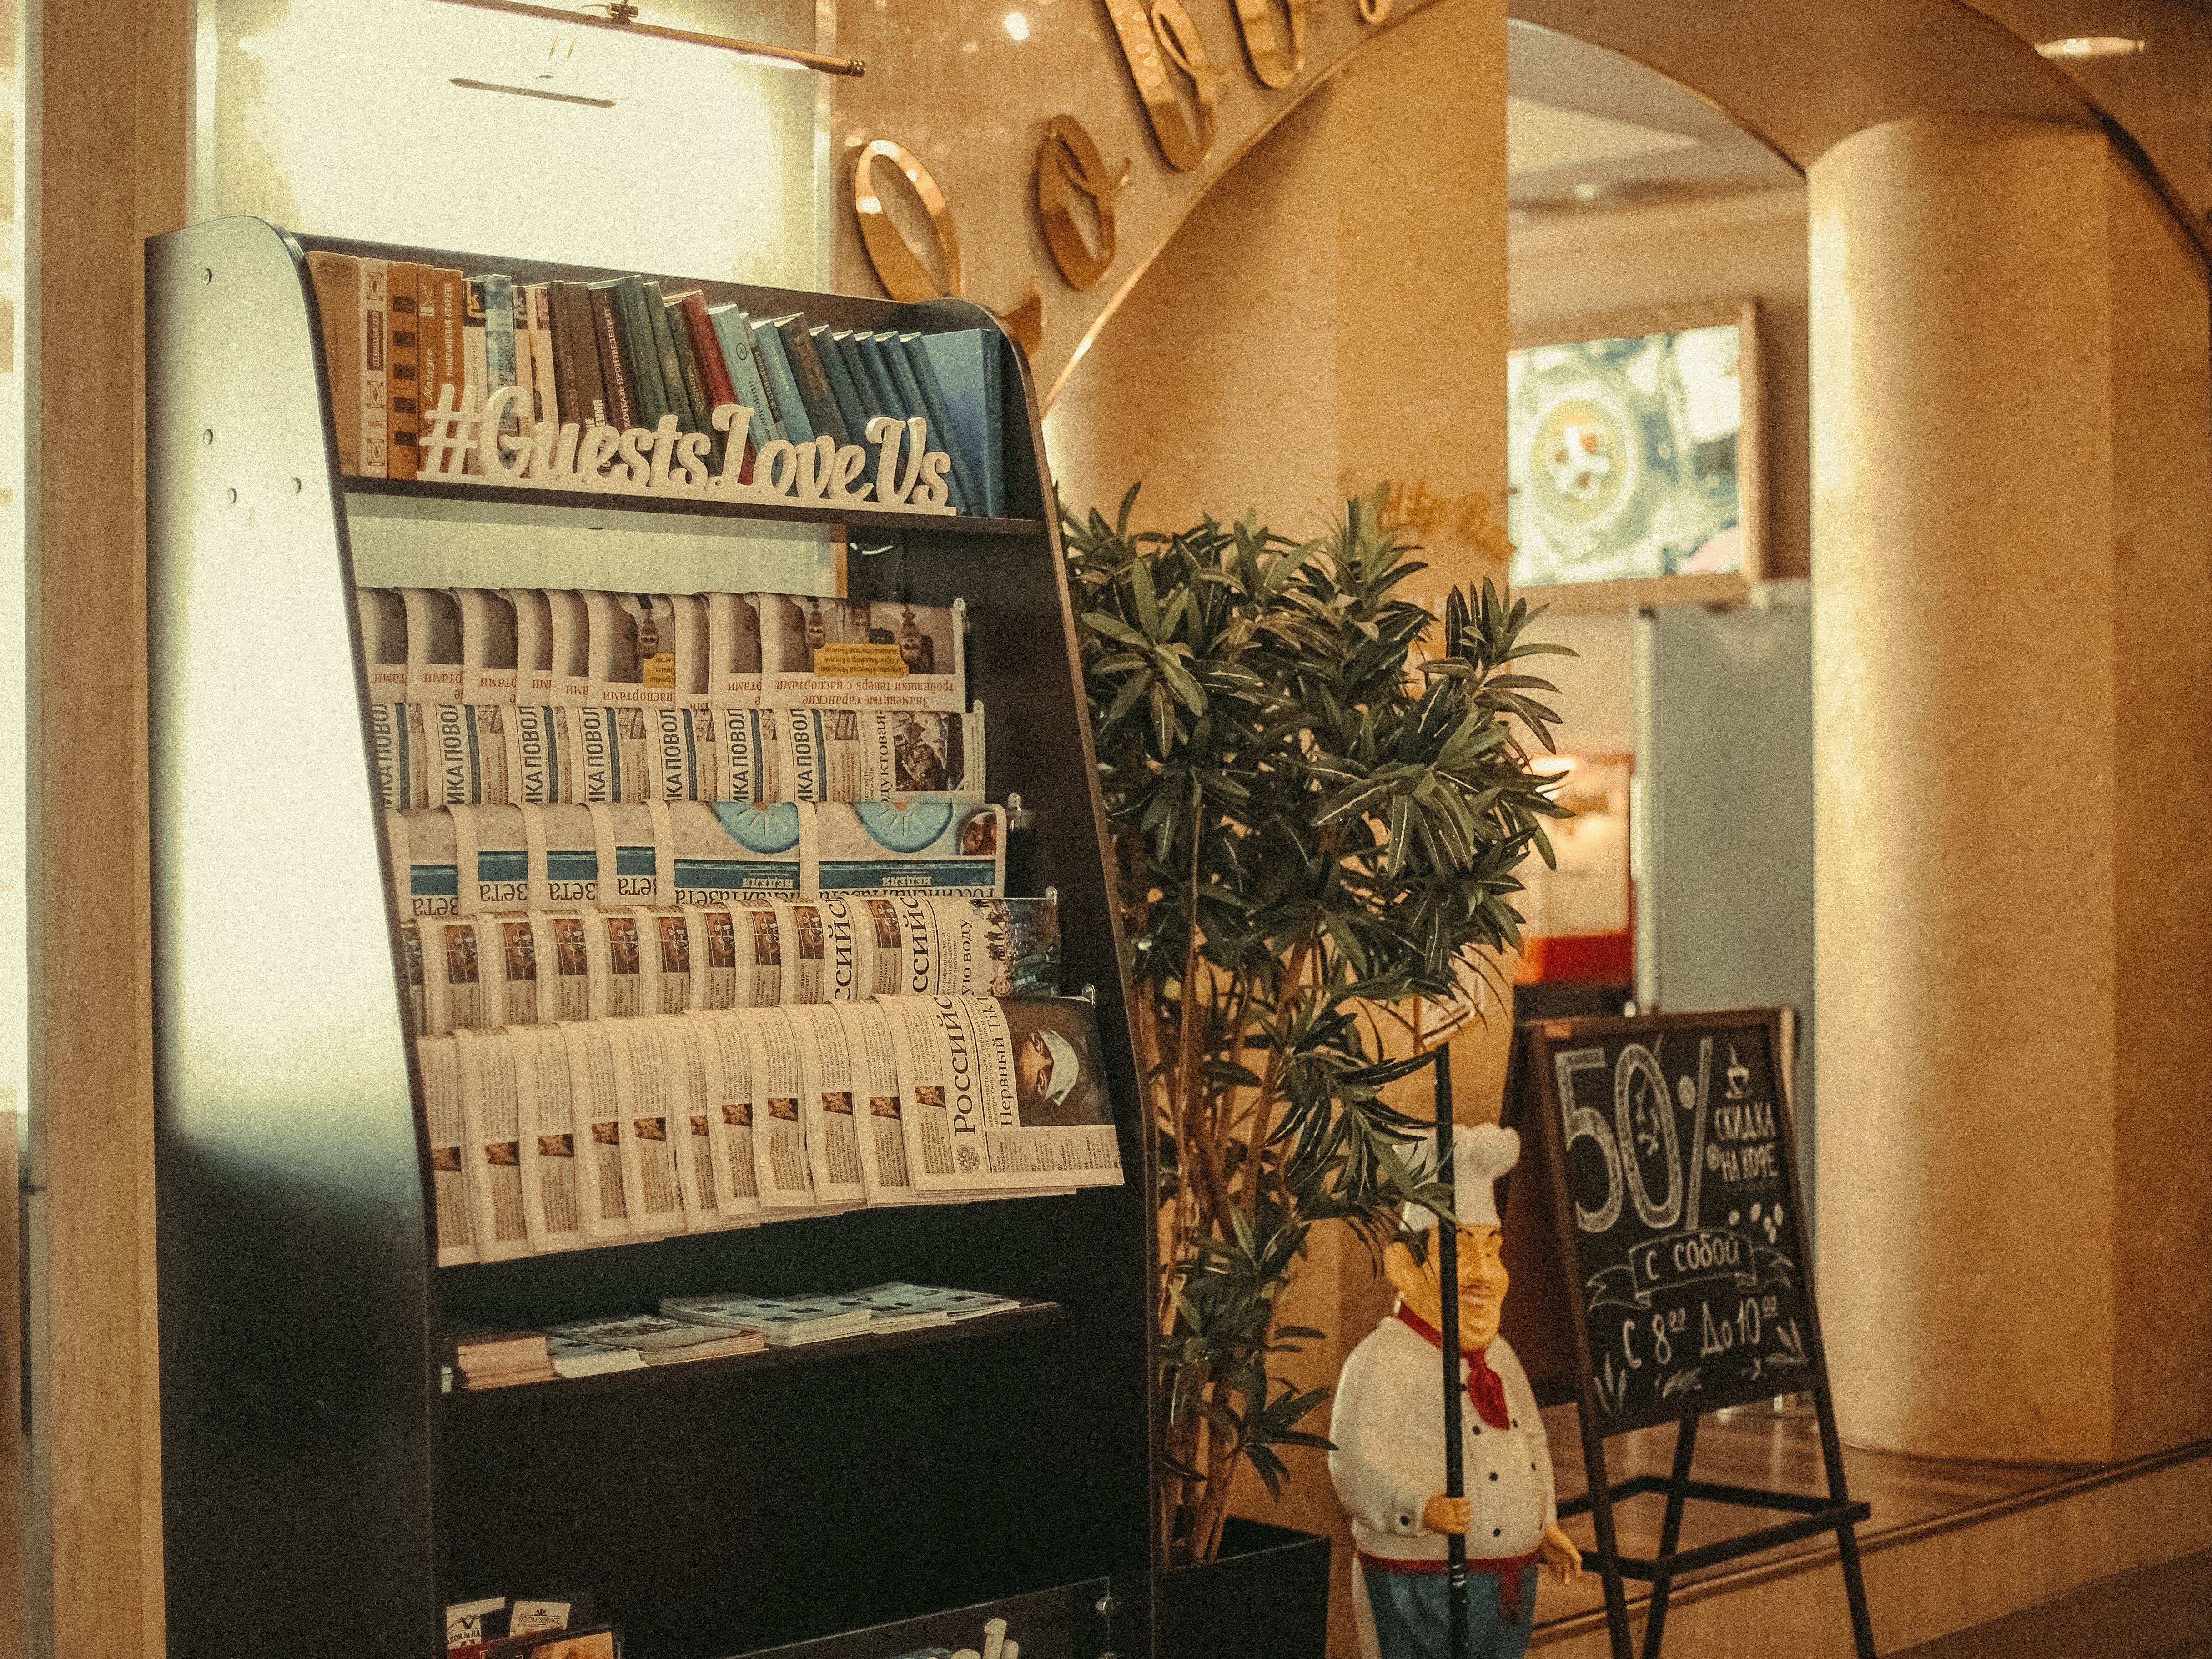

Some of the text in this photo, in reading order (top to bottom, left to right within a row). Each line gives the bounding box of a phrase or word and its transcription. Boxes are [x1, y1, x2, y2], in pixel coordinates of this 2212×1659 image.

[444, 283, 454, 377] ПОШЕХОНСКАЯ СТАРИНА
[618, 386, 631, 427] КОЧКАЗЬ
[749, 380, 768, 427] ДОРОНИН
[603, 689, 673, 702] паспортами
[776, 678, 954, 694] тройняшки теперь с паспортами
[802, 693, 930, 708] Знаменитые саранские
[742, 877, 794, 889] НЕДЕЛЯ
[882, 875, 932, 886] НЕДЕЛЯ
[974, 1021, 988, 1072] Следственный
[981, 1021, 991, 1052] роковым
[987, 1059, 996, 1093] склоняют
[992, 1037, 1014, 1127] Нервный
[984, 1075, 993, 1127] БЕЗОПАСНОСТЬ
[1554, 1037, 1720, 1232] 50%
[1715, 1101, 1776, 1142] СКИДКА
[1720, 1142, 1779, 1182] НА КОФЕ
[1673, 1232, 1740, 1272] собой
